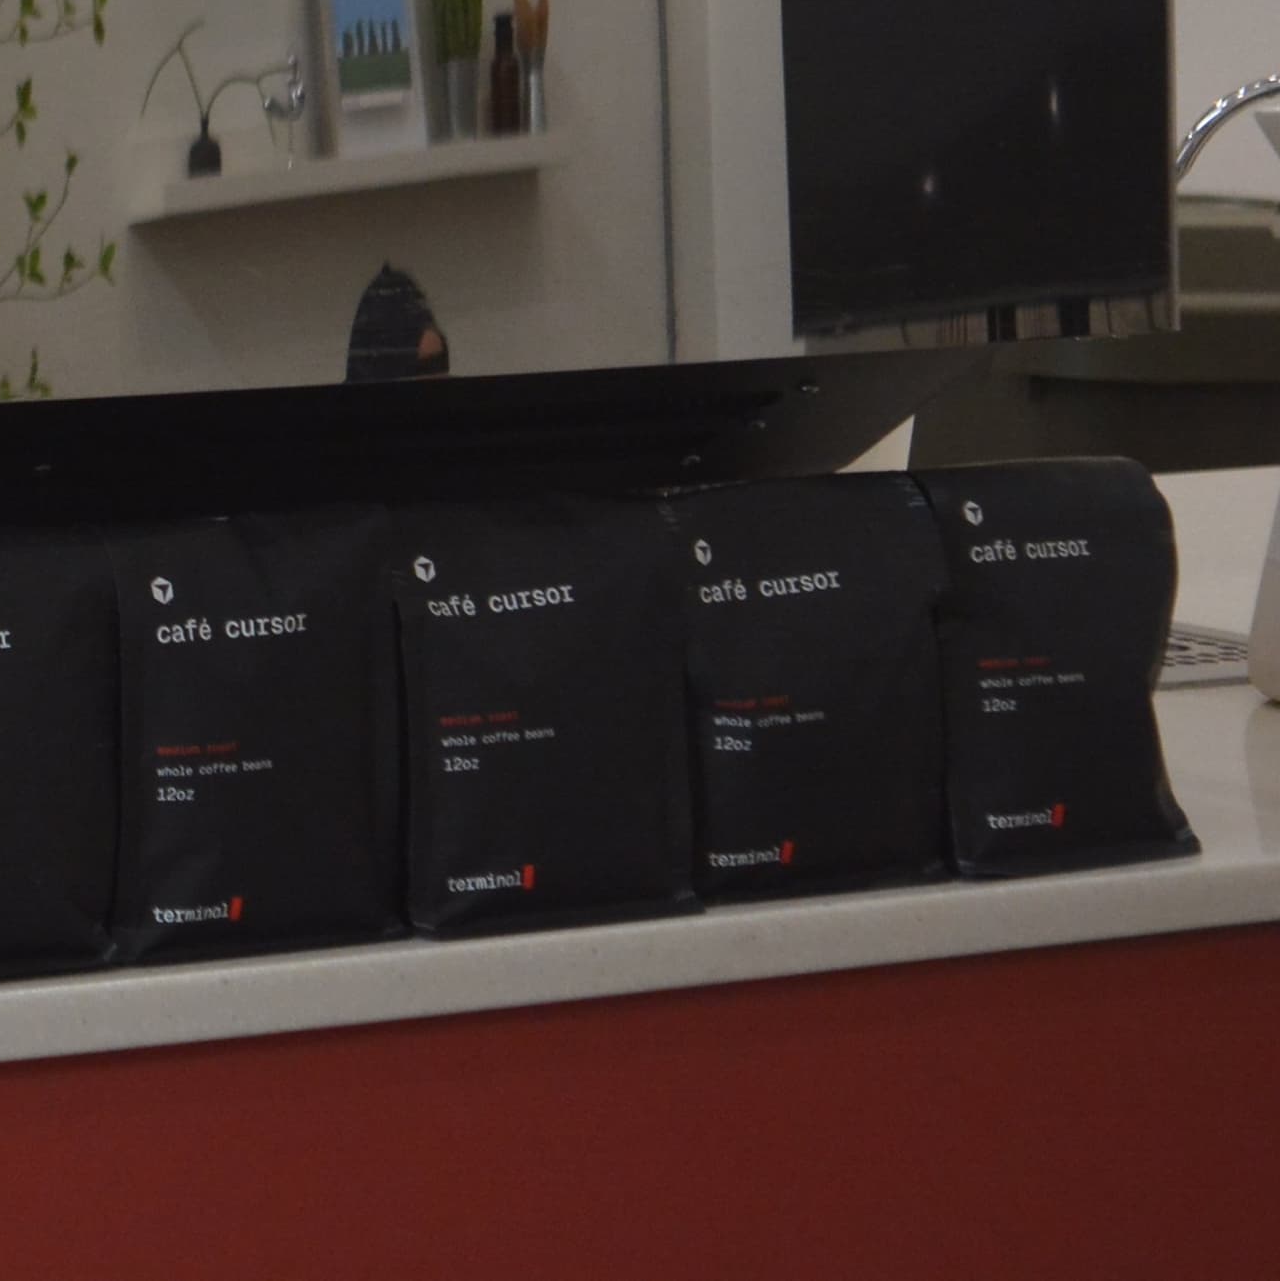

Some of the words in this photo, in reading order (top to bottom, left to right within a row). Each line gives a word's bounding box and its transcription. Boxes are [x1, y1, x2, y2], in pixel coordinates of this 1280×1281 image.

[970, 540, 1017, 563] café
[1025, 539, 1090, 559] cursor
[700, 579, 747, 604] café
[759, 571, 840, 597] cursor
[428, 594, 476, 617] café
[488, 585, 574, 613] cursor
[156, 618, 212, 644] café
[225, 614, 306, 639] cursor
[983, 698, 1016, 712] 12oz
[441, 735, 477, 748] whole
[481, 731, 521, 744] coffee
[715, 736, 752, 751] 12oz
[156, 765, 193, 777] whole
[198, 762, 238, 776] coffee
[444, 756, 479, 772] 12oz
[157, 786, 195, 802] 12oz
[709, 847, 780, 867] terminal
[447, 870, 521, 892] terminal
[152, 902, 228, 924] terminal
